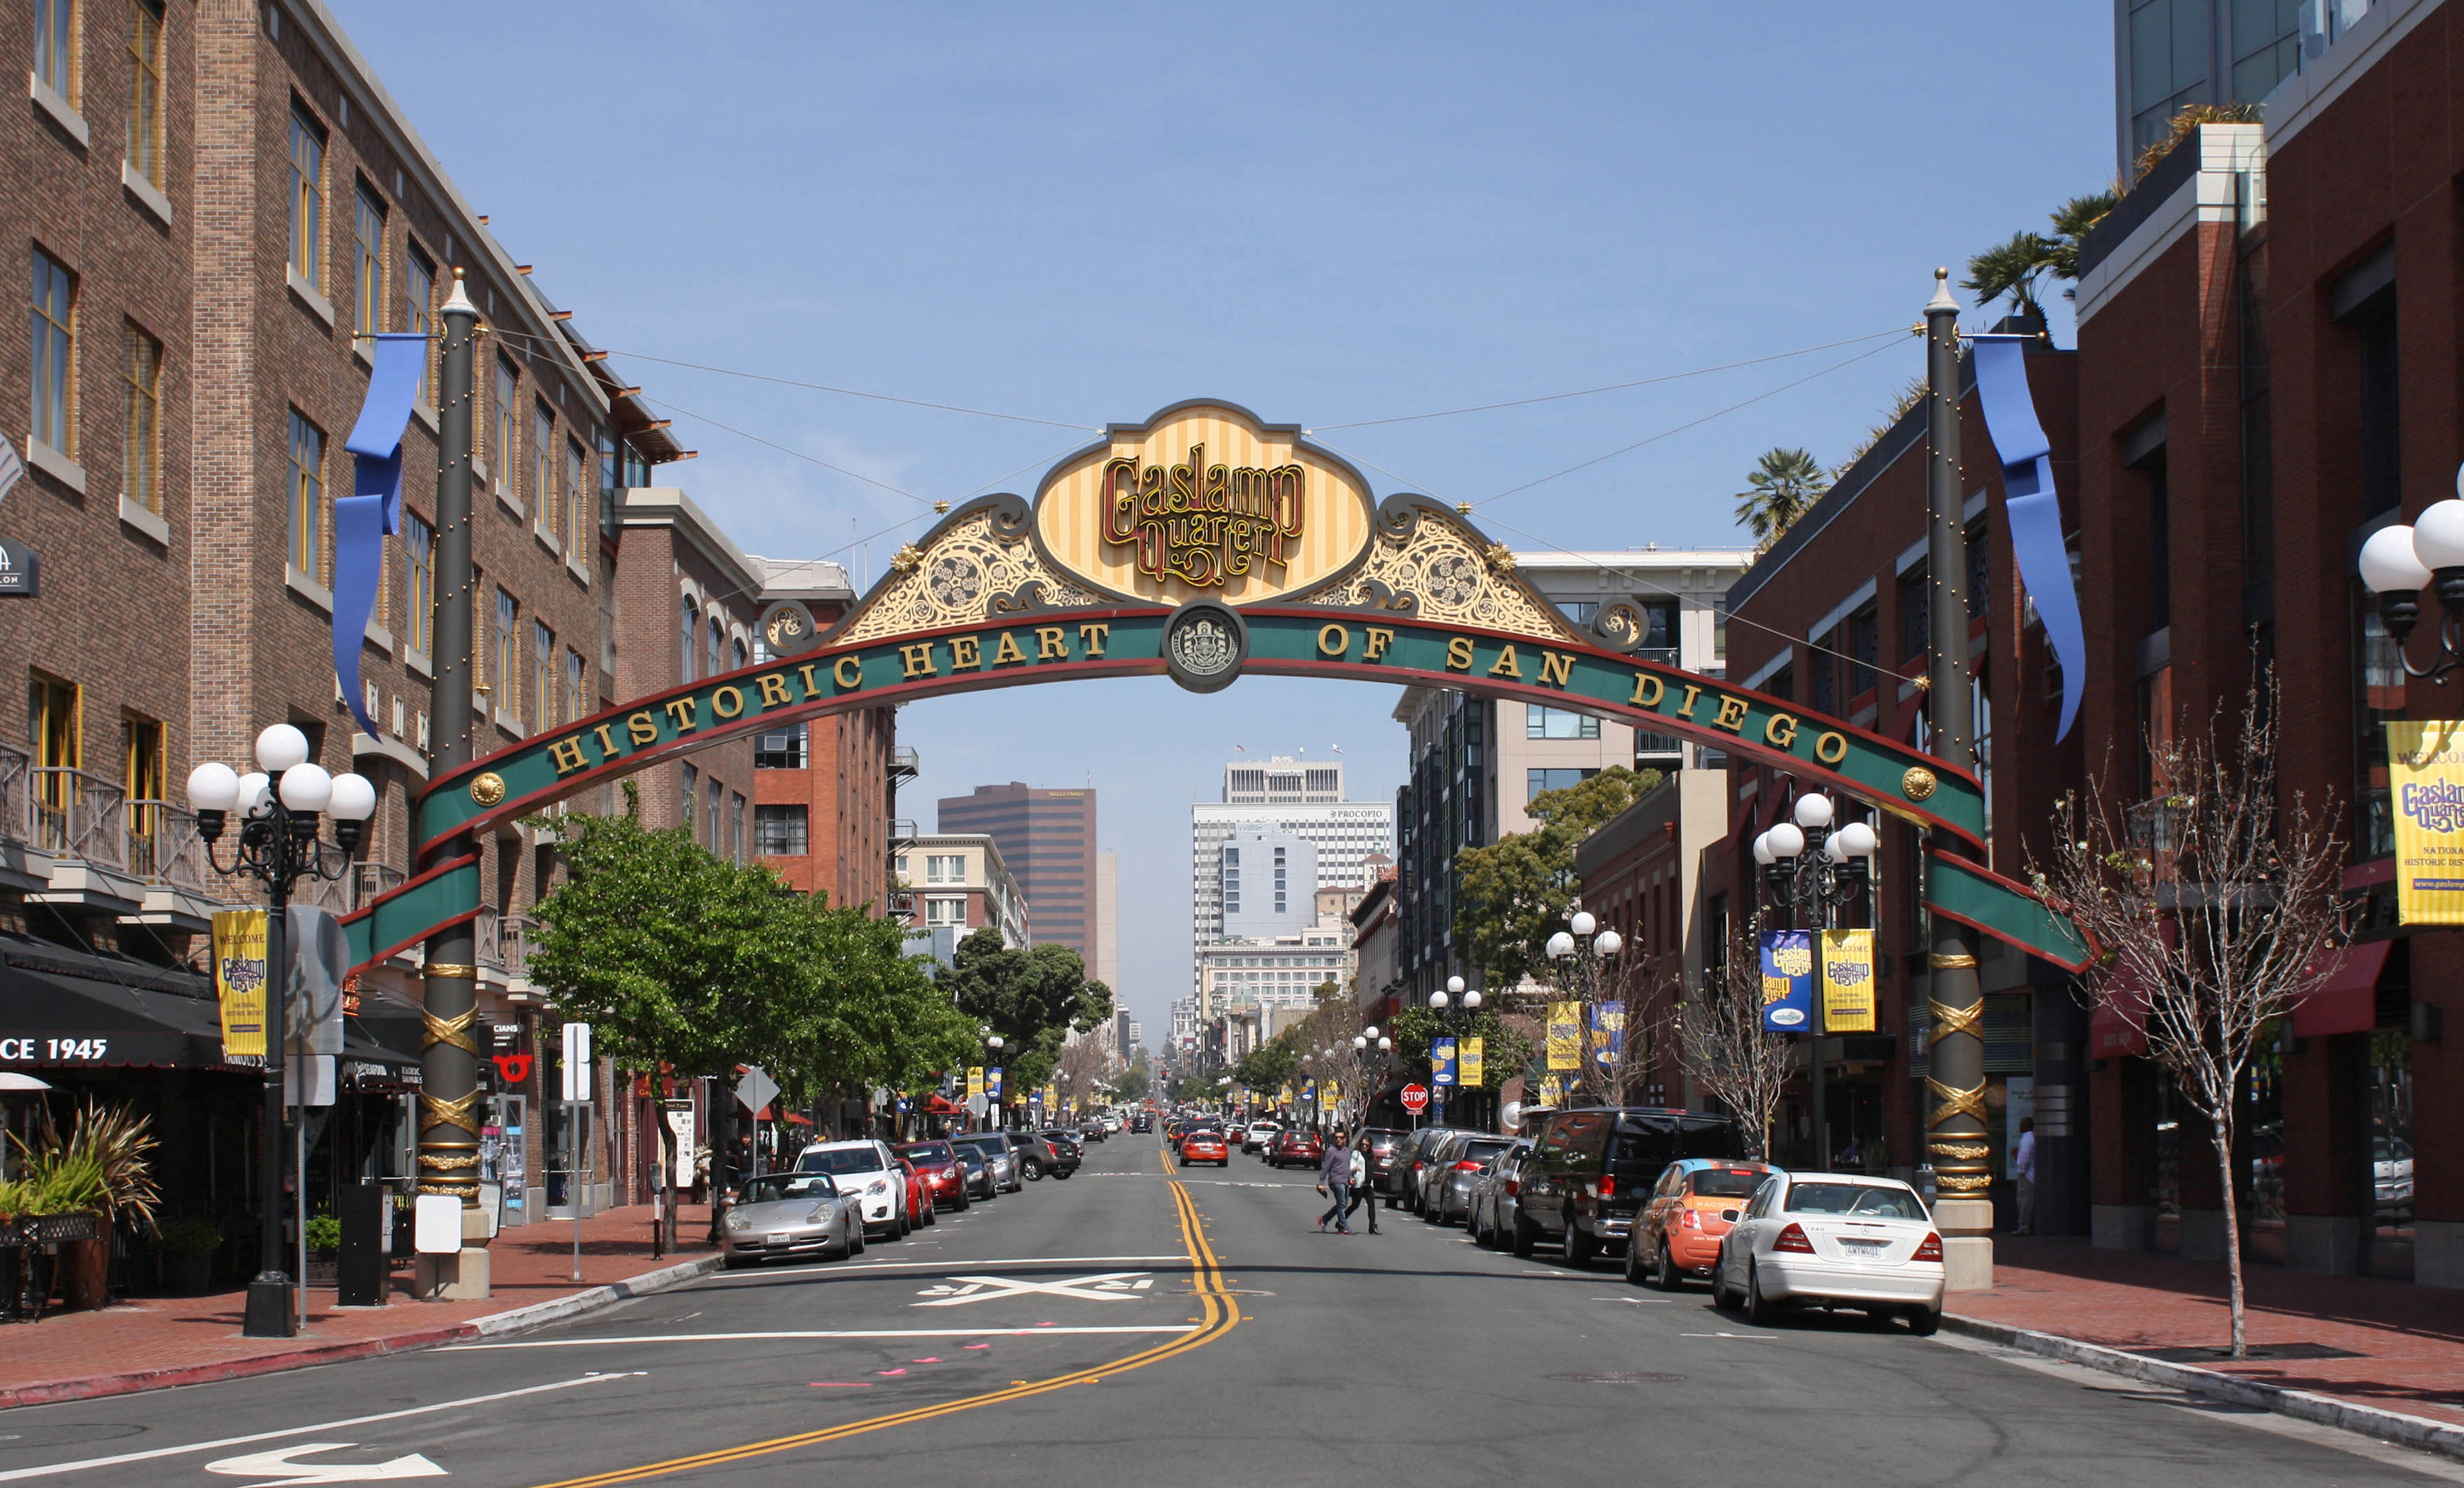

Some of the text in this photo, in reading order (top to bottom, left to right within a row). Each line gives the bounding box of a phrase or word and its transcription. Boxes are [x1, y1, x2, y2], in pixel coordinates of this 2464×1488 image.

[1103, 442, 1305, 567] Gaslamp
[1137, 514, 1272, 587] Quarter
[547, 624, 1848, 775] HISTORIC HEART OF SAN DIEGO
[218, 933, 265, 945] WELCOME
[1826, 944, 1869, 953] WELCOME
[222, 954, 265, 981] Gaslamp
[1827, 959, 1870, 978] Gaslamp
[0, 1038, 107, 1060] CE 1945
[1403, 1091, 1425, 1102] STOP
